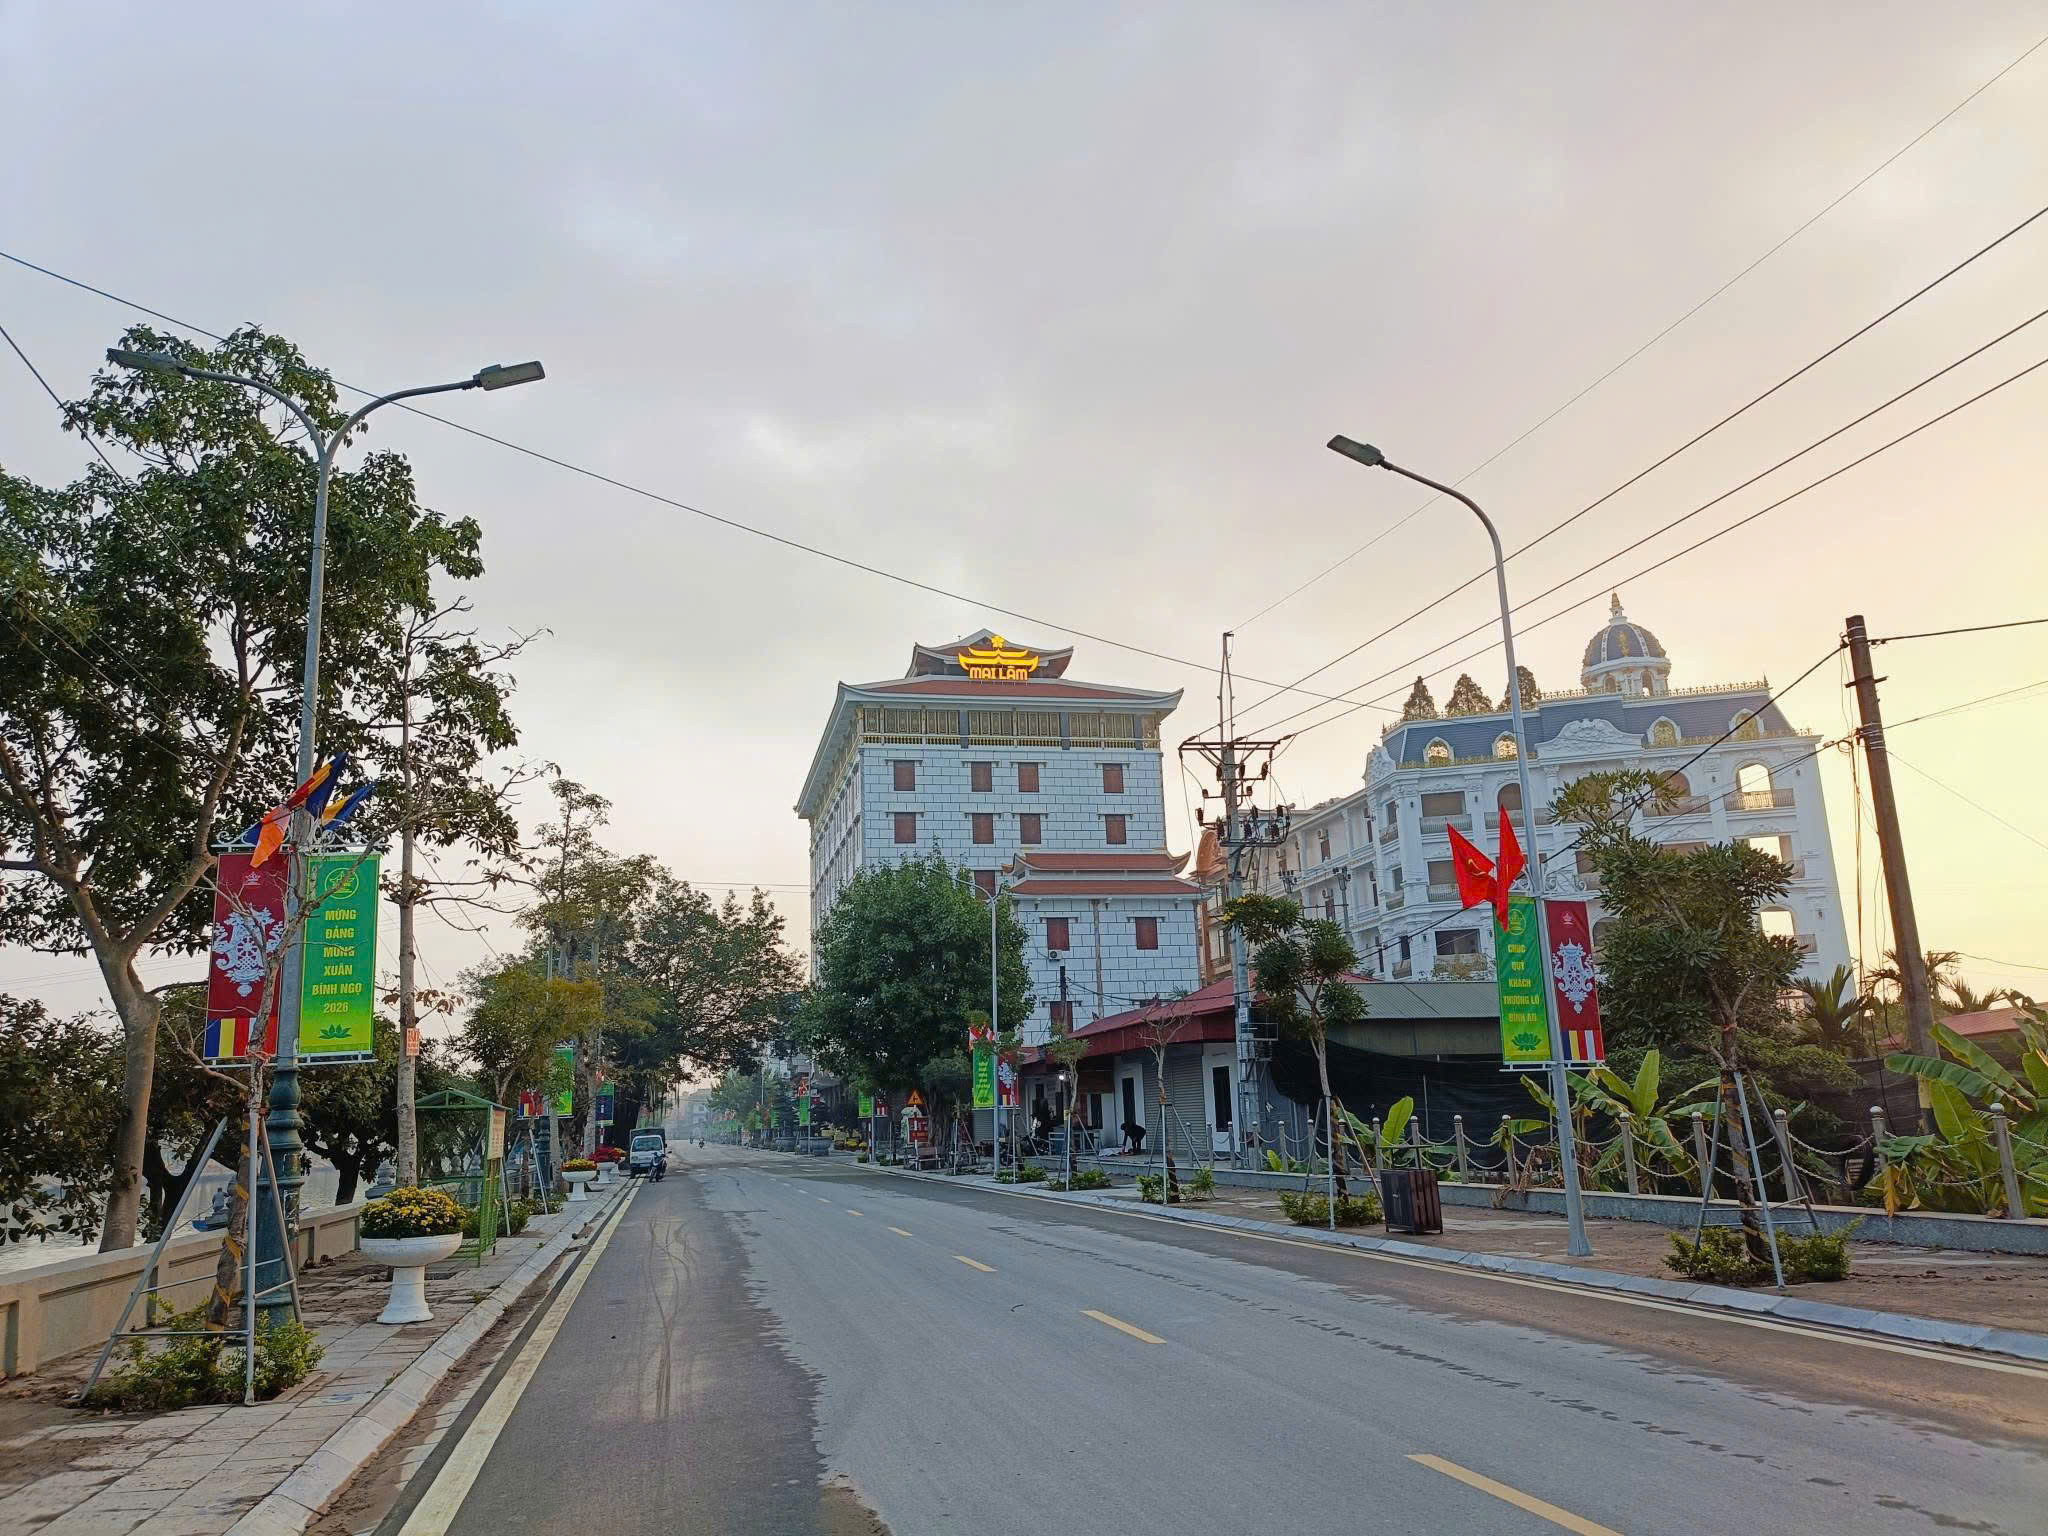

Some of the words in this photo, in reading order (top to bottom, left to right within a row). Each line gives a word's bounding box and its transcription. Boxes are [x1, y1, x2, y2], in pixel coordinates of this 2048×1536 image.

[969, 667, 997, 679] MAI
[324, 962, 352, 976] XUÂN
[340, 982, 362, 995] NGỌ
[323, 1002, 349, 1014] 2026
